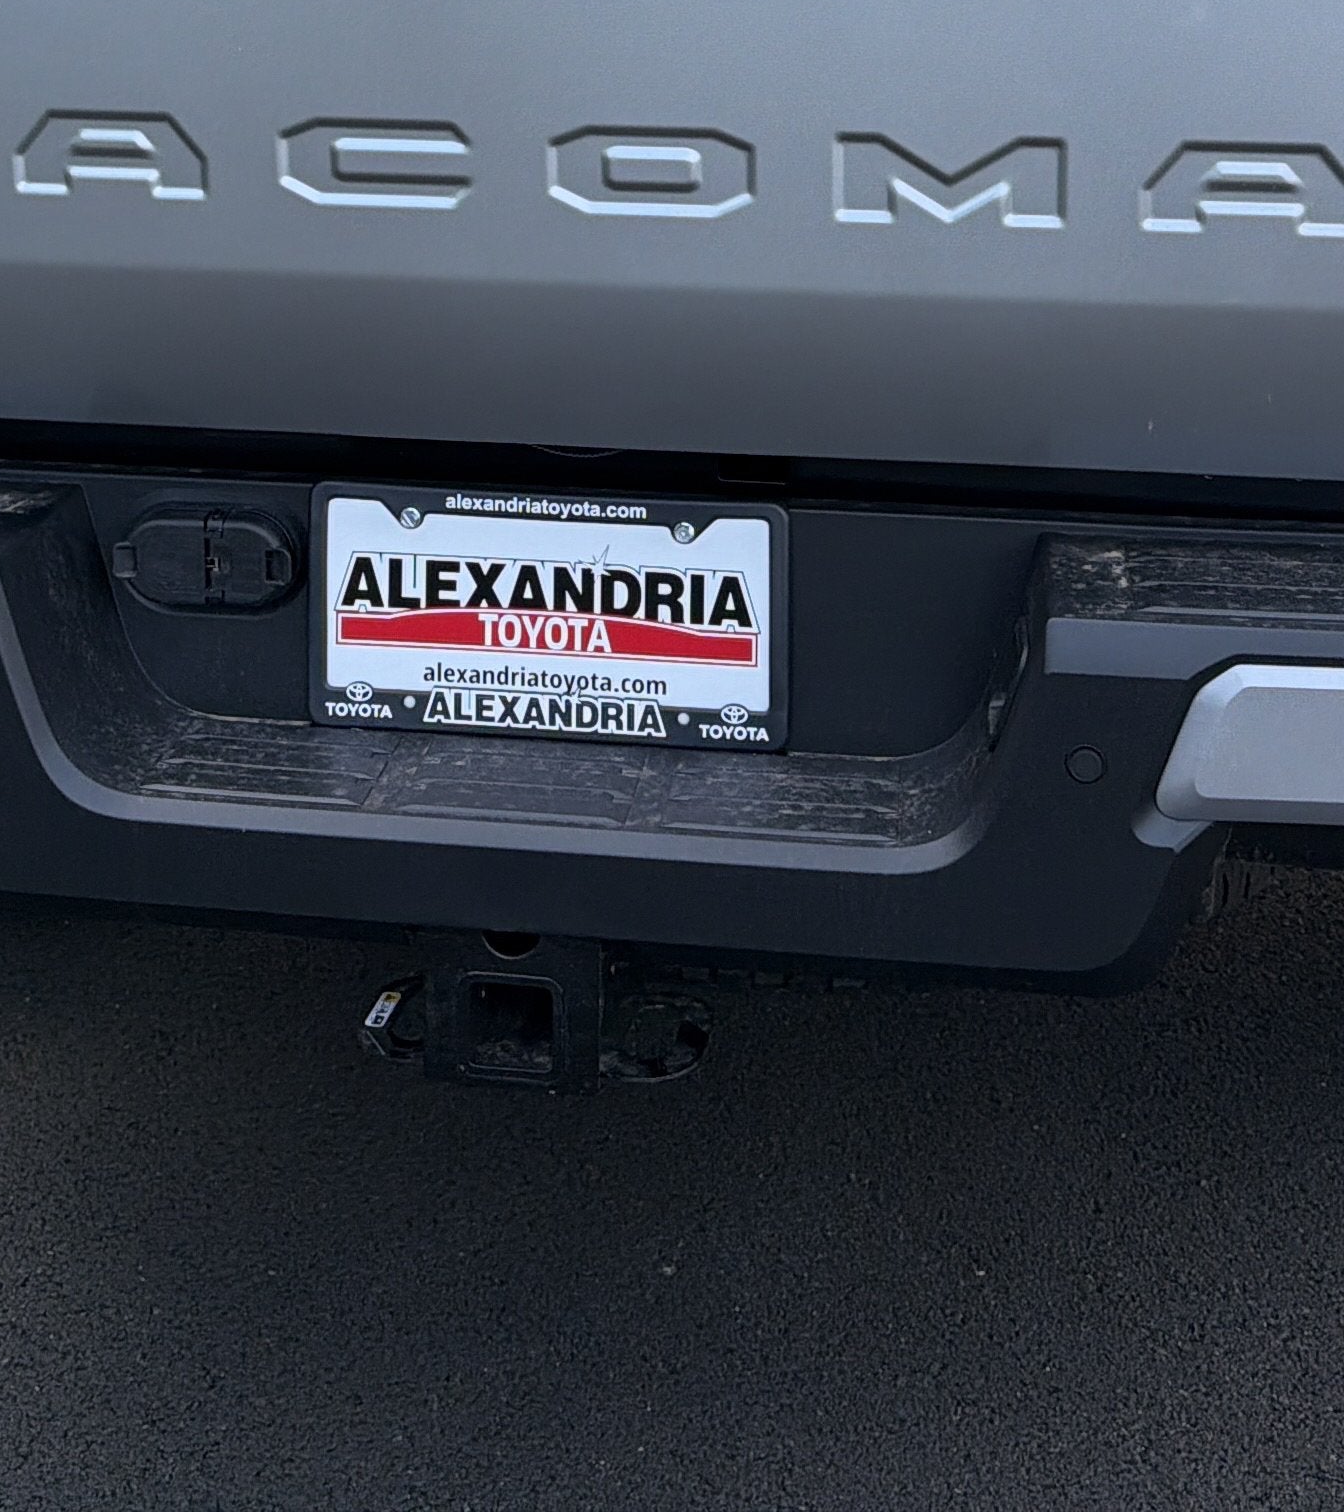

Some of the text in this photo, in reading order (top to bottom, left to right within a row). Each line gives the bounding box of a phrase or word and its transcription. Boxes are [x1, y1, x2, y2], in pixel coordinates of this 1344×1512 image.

[444, 494, 648, 520] alexandriatoyota.com
[341, 557, 752, 628] ALEXANDRIA
[477, 613, 612, 654] TOYOTA
[423, 662, 668, 696] alexandriatoyota.com
[325, 701, 393, 720] TOYOTA
[423, 689, 667, 738] ALEXANDRIA
[699, 725, 770, 744] TOYOTA
